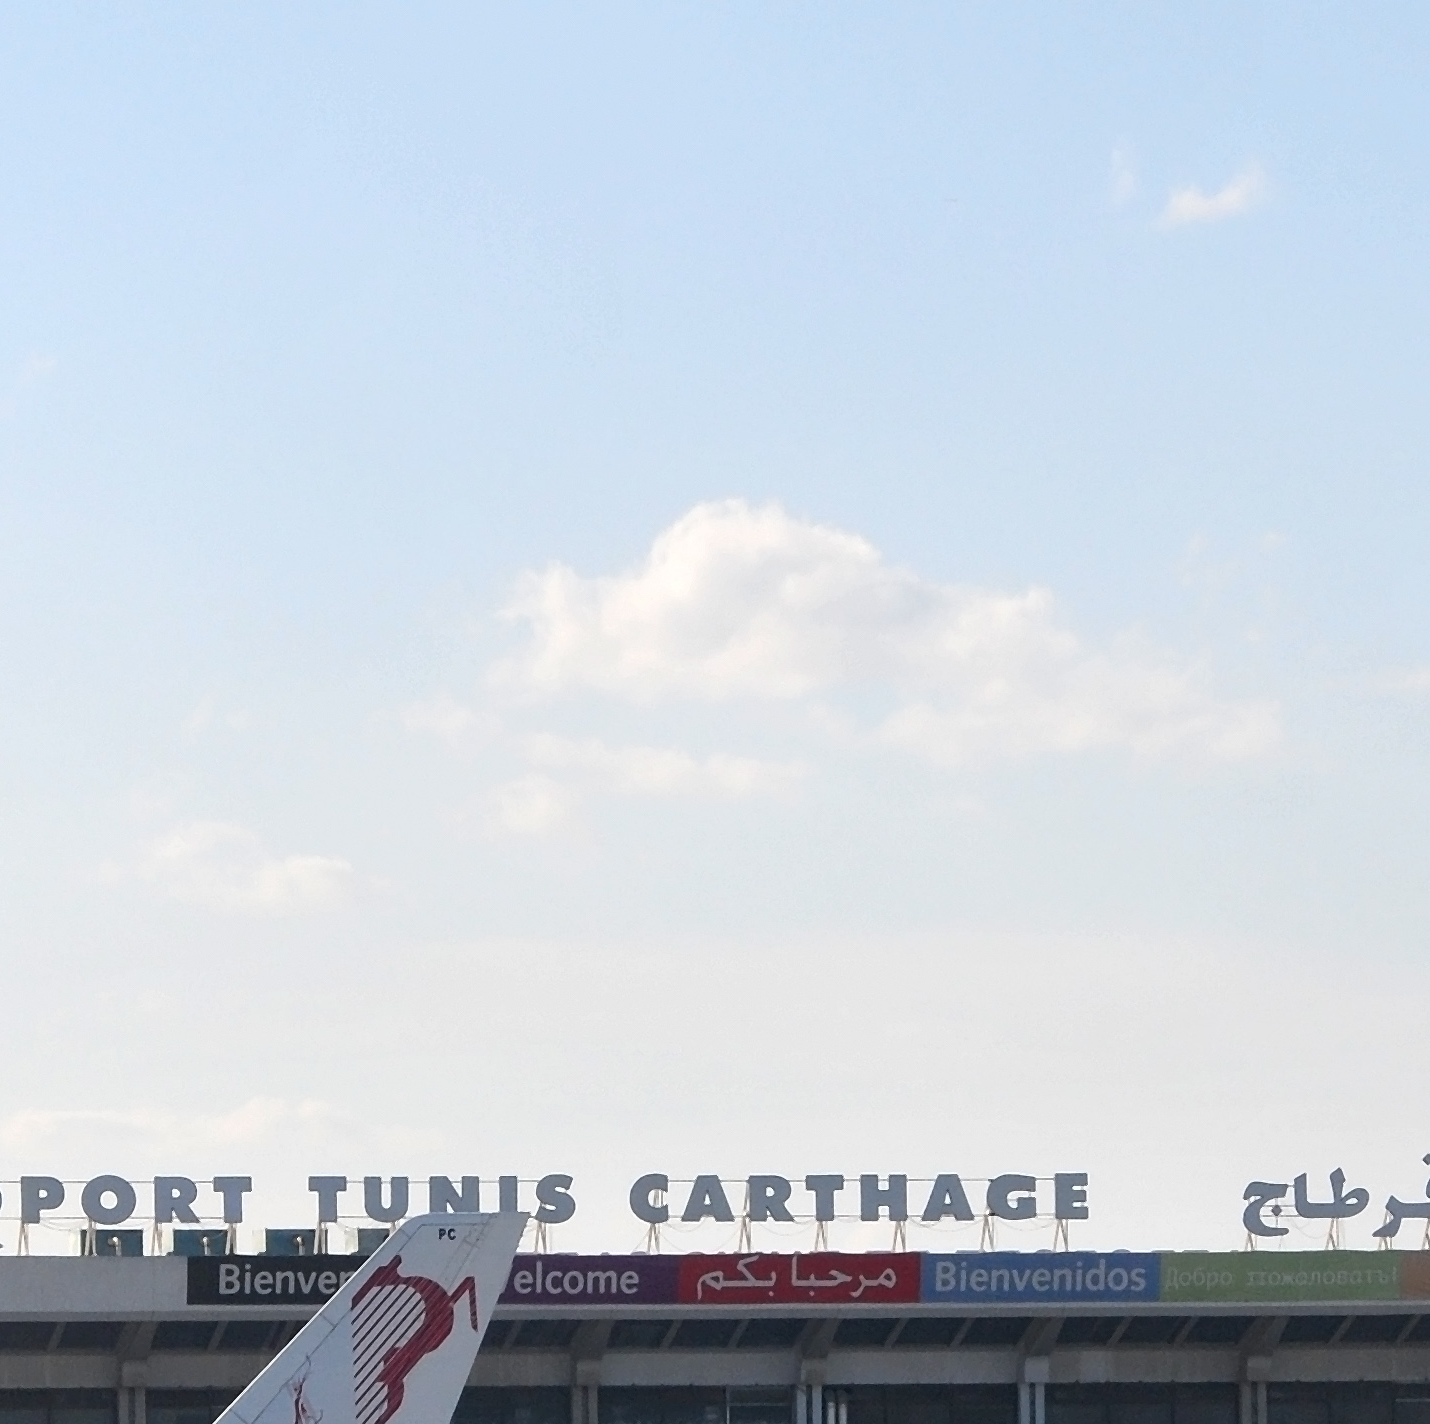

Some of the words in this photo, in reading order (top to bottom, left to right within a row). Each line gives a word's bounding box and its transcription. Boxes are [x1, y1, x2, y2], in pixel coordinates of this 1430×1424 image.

[309, 1174, 576, 1224] TUNIS
[629, 1173, 1090, 1223] CARTHAGE
[437, 1228, 457, 1241] PC
[512, 1260, 640, 1295] elcome
[696, 1254, 777, 1300] بكم
[790, 1254, 897, 1298] مرحبا
[935, 1258, 1147, 1292] Bienvenidos
[1165, 1267, 1234, 1291] Добро
